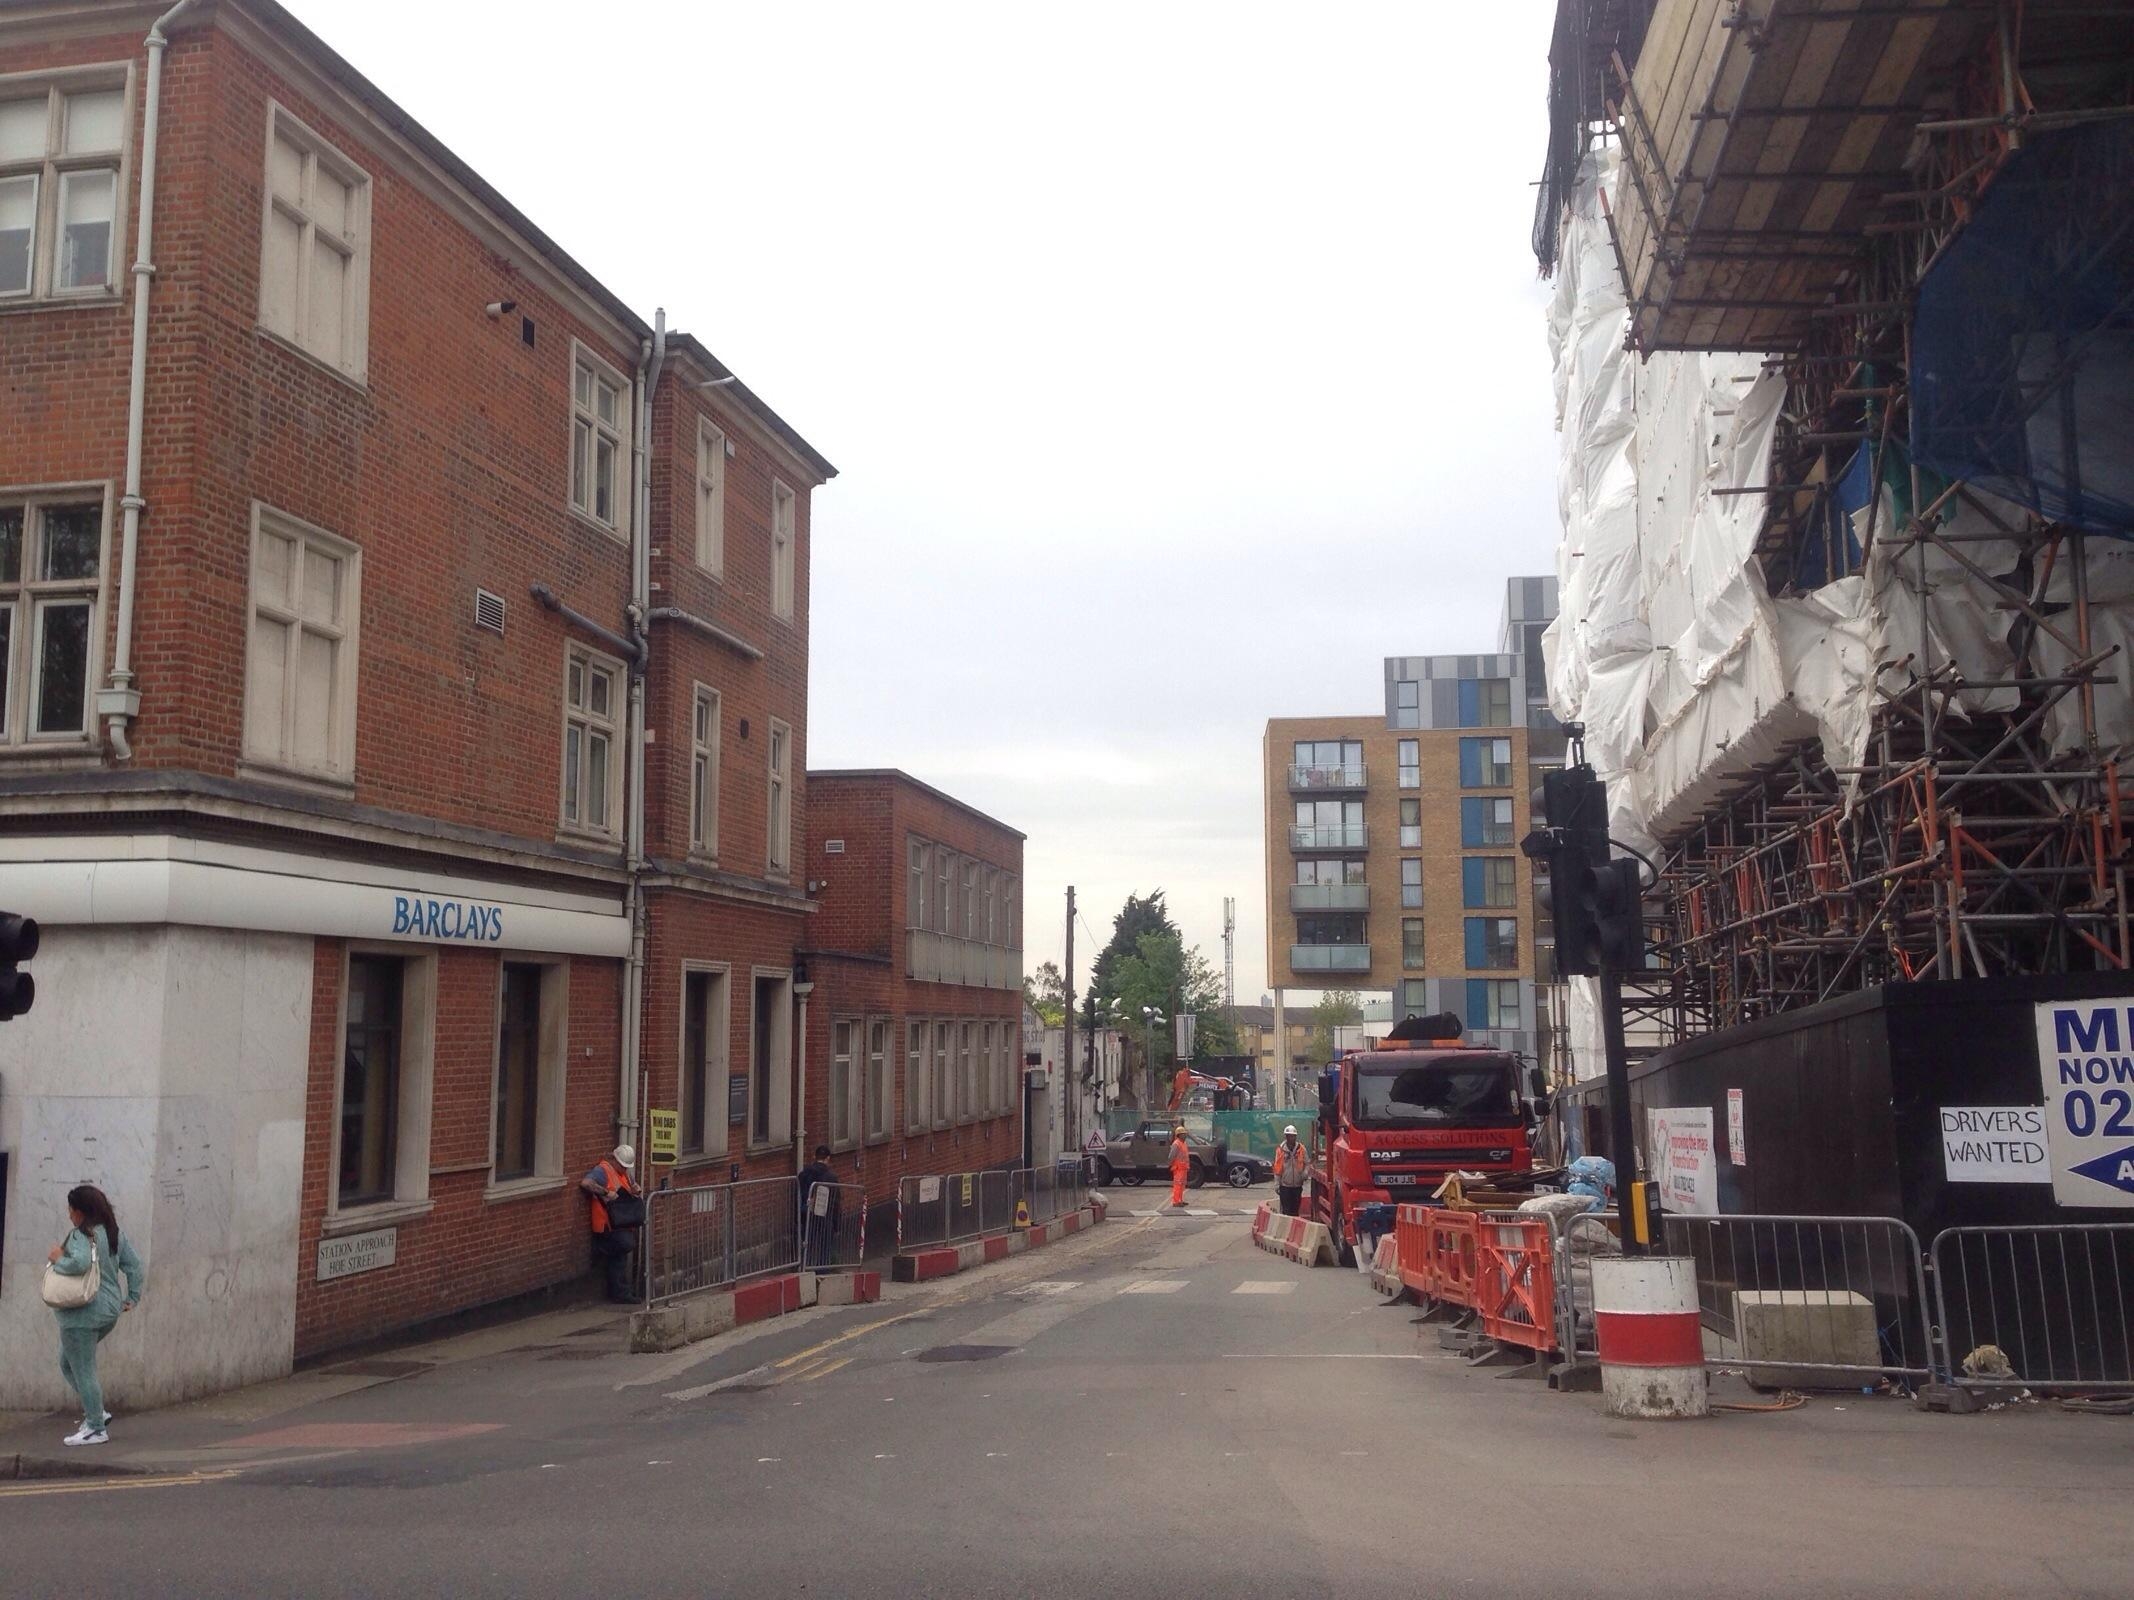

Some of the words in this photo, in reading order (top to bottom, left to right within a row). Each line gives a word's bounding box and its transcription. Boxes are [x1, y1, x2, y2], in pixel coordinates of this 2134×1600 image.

[393, 896, 502, 941] BARCLAYS
[2059, 1056, 2134, 1084] NOW
[1942, 1110, 2042, 1133] DRIVERS
[2064, 1089, 2134, 1137] 02
[1375, 1131, 1428, 1146] ACCESS
[1431, 1131, 1507, 1145] SOLUTIONS
[1946, 1141, 2044, 1164] WANTED
[2117, 1159, 2134, 1180] A
[320, 1241, 352, 1260] STATION
[355, 1233, 394, 1252] APPROACH
[329, 1258, 346, 1275] HOE
[348, 1252, 376, 1271] STREET
